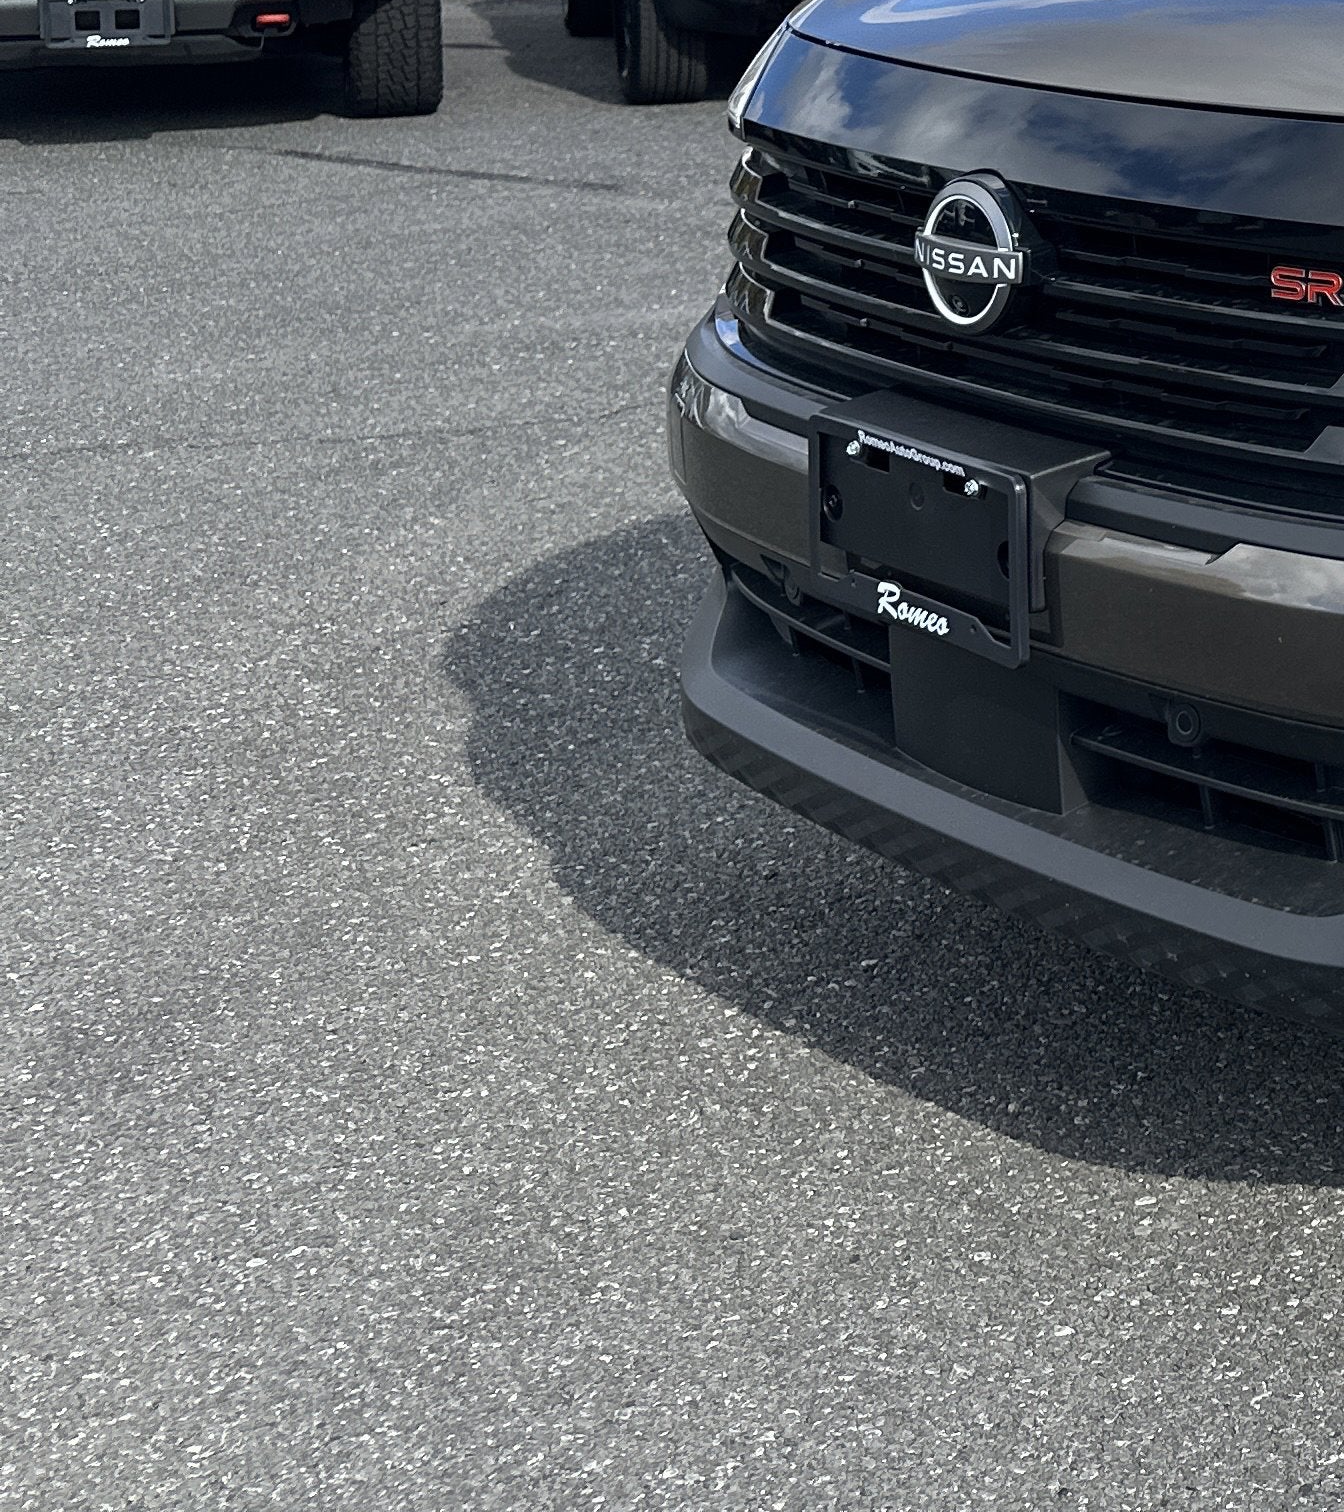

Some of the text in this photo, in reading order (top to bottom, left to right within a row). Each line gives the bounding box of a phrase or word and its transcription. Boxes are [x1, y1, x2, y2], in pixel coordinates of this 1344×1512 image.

[915, 238, 1016, 280] NISSAN
[1271, 266, 1344, 307] SR
[877, 581, 950, 636] Romeo
